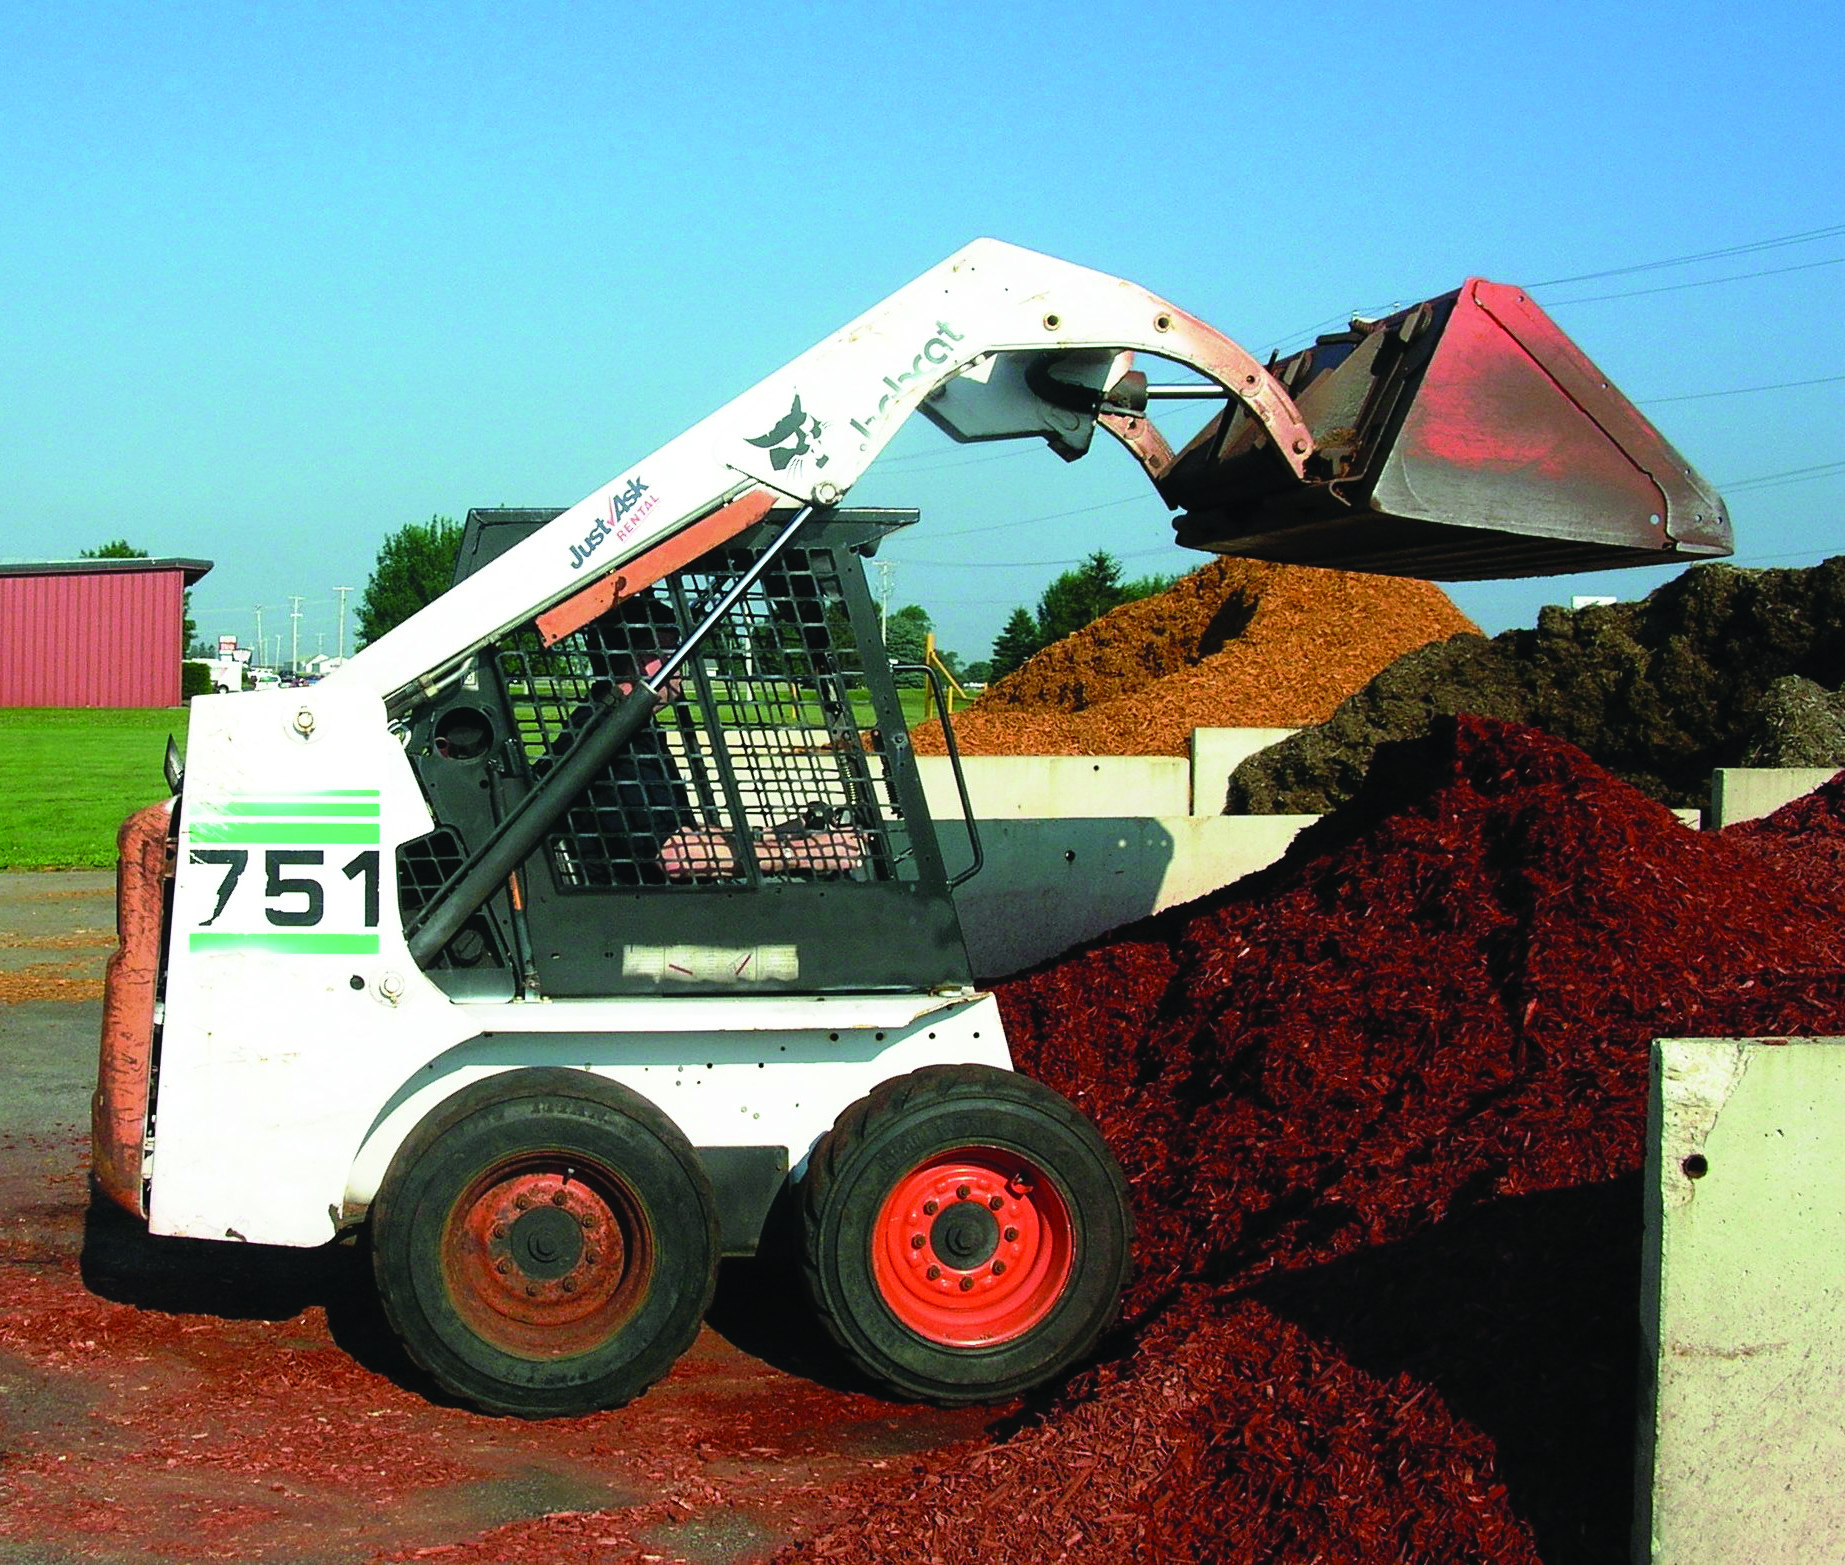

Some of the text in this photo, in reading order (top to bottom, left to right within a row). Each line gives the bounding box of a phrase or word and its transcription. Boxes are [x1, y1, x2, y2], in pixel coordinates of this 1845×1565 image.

[569, 475, 649, 569] Just Ask
[616, 495, 660, 542] RENTAL
[189, 850, 380, 927] 751
